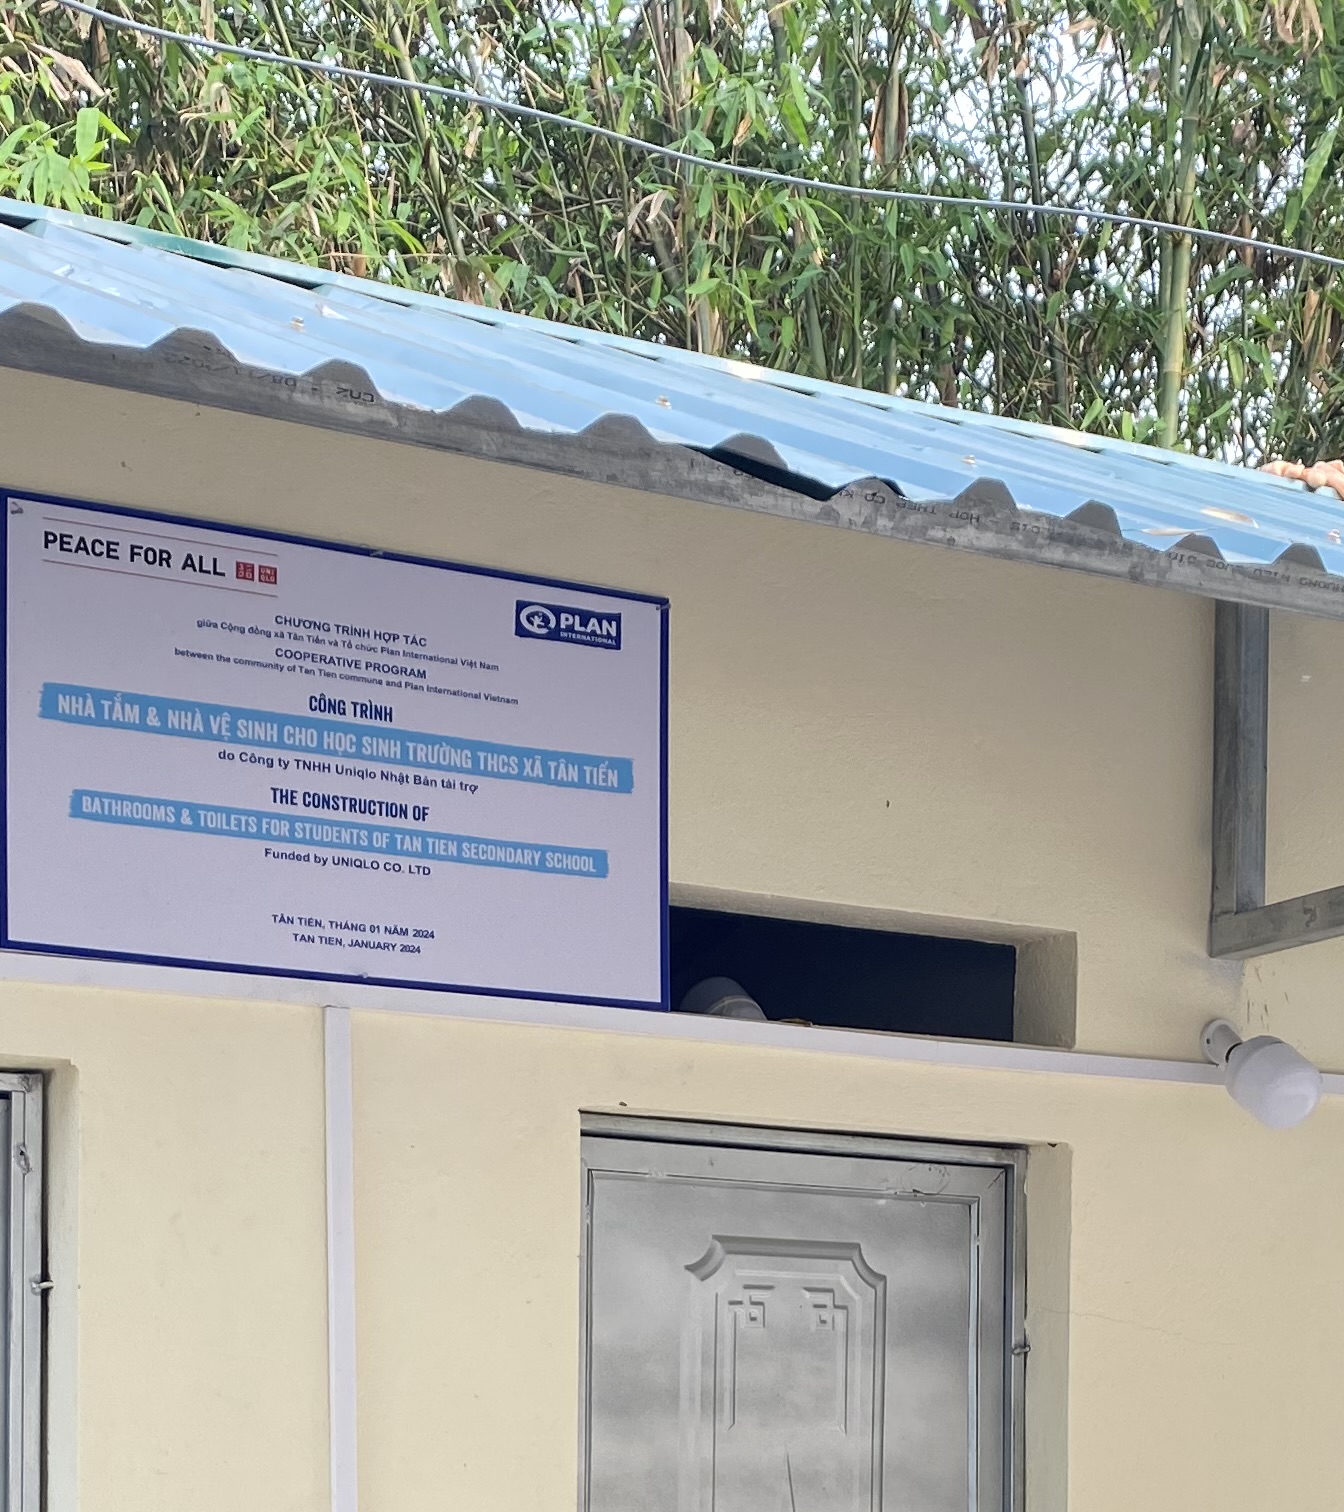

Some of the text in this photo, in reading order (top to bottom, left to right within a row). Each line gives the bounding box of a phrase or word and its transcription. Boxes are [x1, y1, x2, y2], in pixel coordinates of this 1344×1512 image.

[43, 530, 226, 577] PEACE FOR ALL
[275, 615, 427, 647] CHƯƠNG TRÌNH HỢP TÁC
[560, 612, 617, 637] PLAN
[560, 632, 616, 645] INTERNATIONAL
[275, 648, 427, 679] COOPERATIVE PROGRAM
[380, 646, 400, 657] Plan
[403, 650, 458, 664] International
[479, 662, 499, 671] Nam
[174, 647, 519, 705] between the community of Tan Tien commune and Plan International Vietnam
[309, 693, 393, 723] CÔNG TRÌNH
[58, 692, 619, 788] NHÀ TẮM & NHÀ VỆ SINH CHO HỌC SINH TRƯỜNG THCS XÃ TÂN TIẾN
[218, 749, 236, 761] do
[239, 751, 274, 768] Công
[277, 757, 290, 770] ty
[294, 758, 331, 774] TNHH
[335, 764, 377, 780] Uniqlo
[380, 770, 410, 785] Nhật
[459, 781, 479, 795] trợ
[270, 787, 430, 822] THE CONSTRUCTION OF
[82, 795, 597, 873] BATHROOMS & TOILETS FOR STUDENTS OF TAN TIEN SECONDARY SCHOOL
[264, 847, 431, 876] Funded by UNIQLO CO. LTD
[272, 913, 295, 925] TÂN
[328, 920, 367, 933] THÁNG
[369, 924, 381, 934] 01
[384, 924, 409, 937] NĂM
[412, 928, 435, 939] 2024
[292, 932, 421, 954] TAN TIEN, JANUARY 2024
